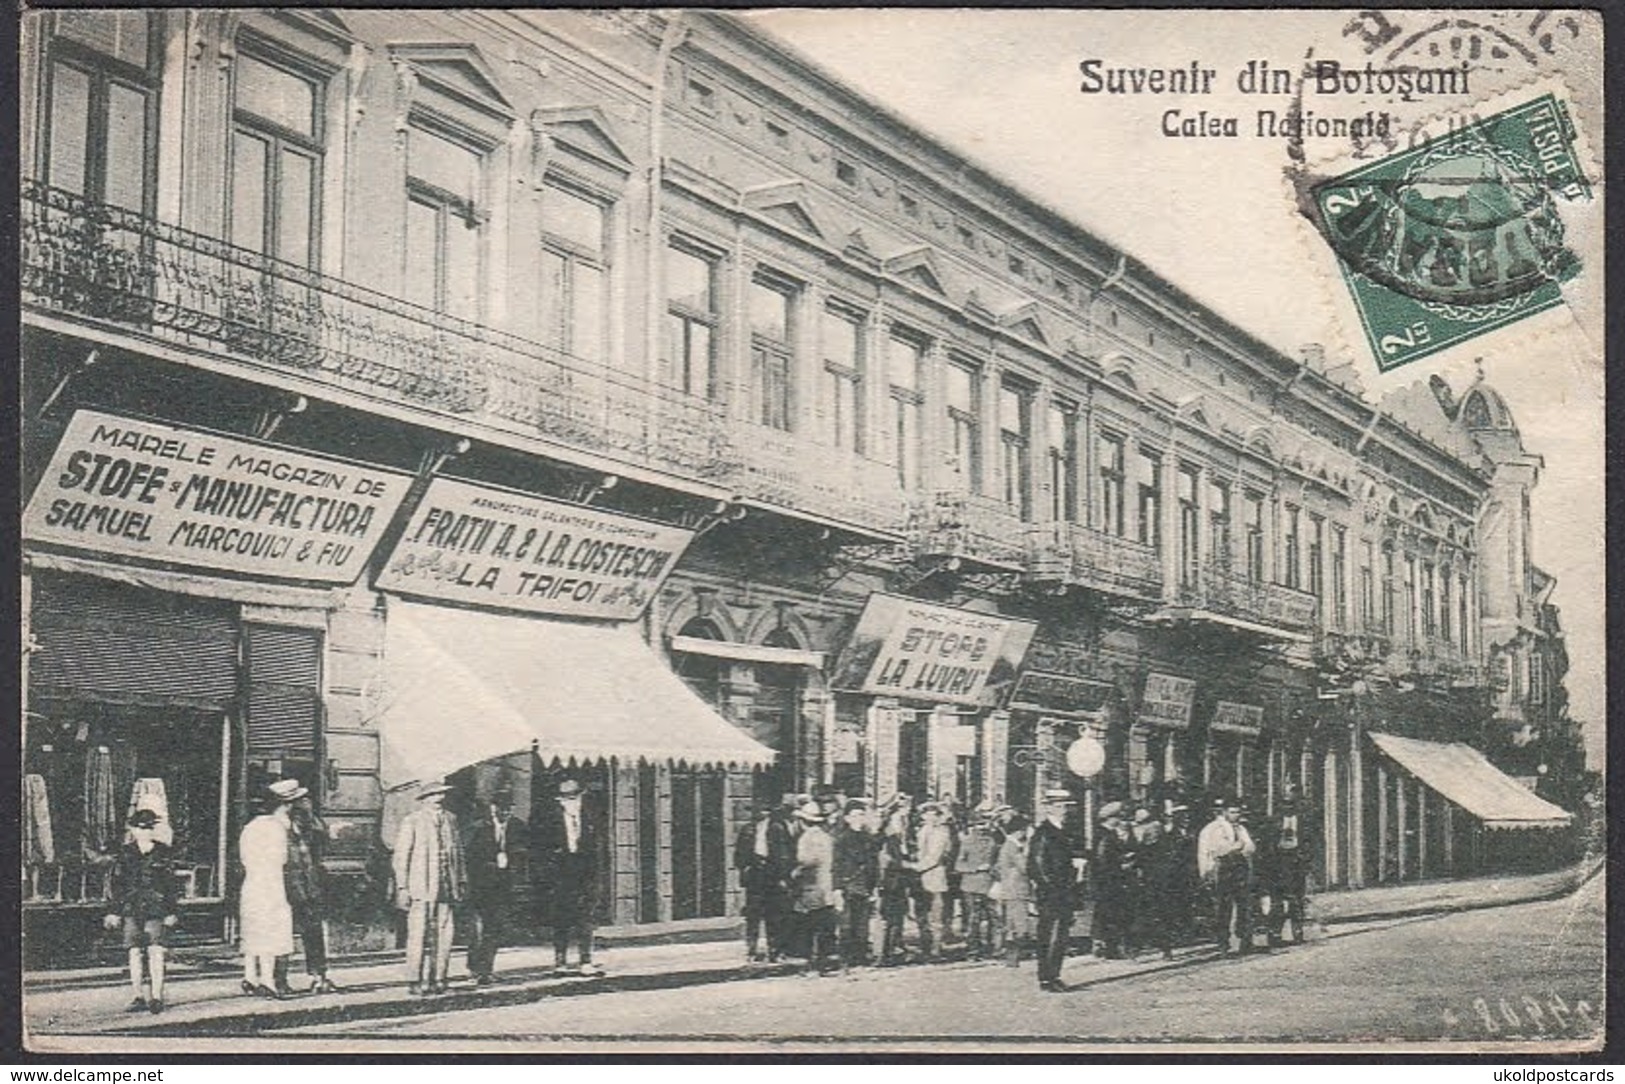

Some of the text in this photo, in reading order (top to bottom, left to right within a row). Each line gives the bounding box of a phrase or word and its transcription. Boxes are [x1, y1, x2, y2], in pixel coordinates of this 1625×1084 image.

[89, 424, 389, 498] MARELE MAGAZIN DE
[58, 449, 170, 504] STOFE
[175, 475, 375, 538] MANUFACTURA
[45, 498, 355, 568] SAMUEL MARCOVICI & FIU
[515, 527, 538, 562] &
[455, 563, 603, 603] LA TRIFOI
[876, 656, 909, 688] LA
